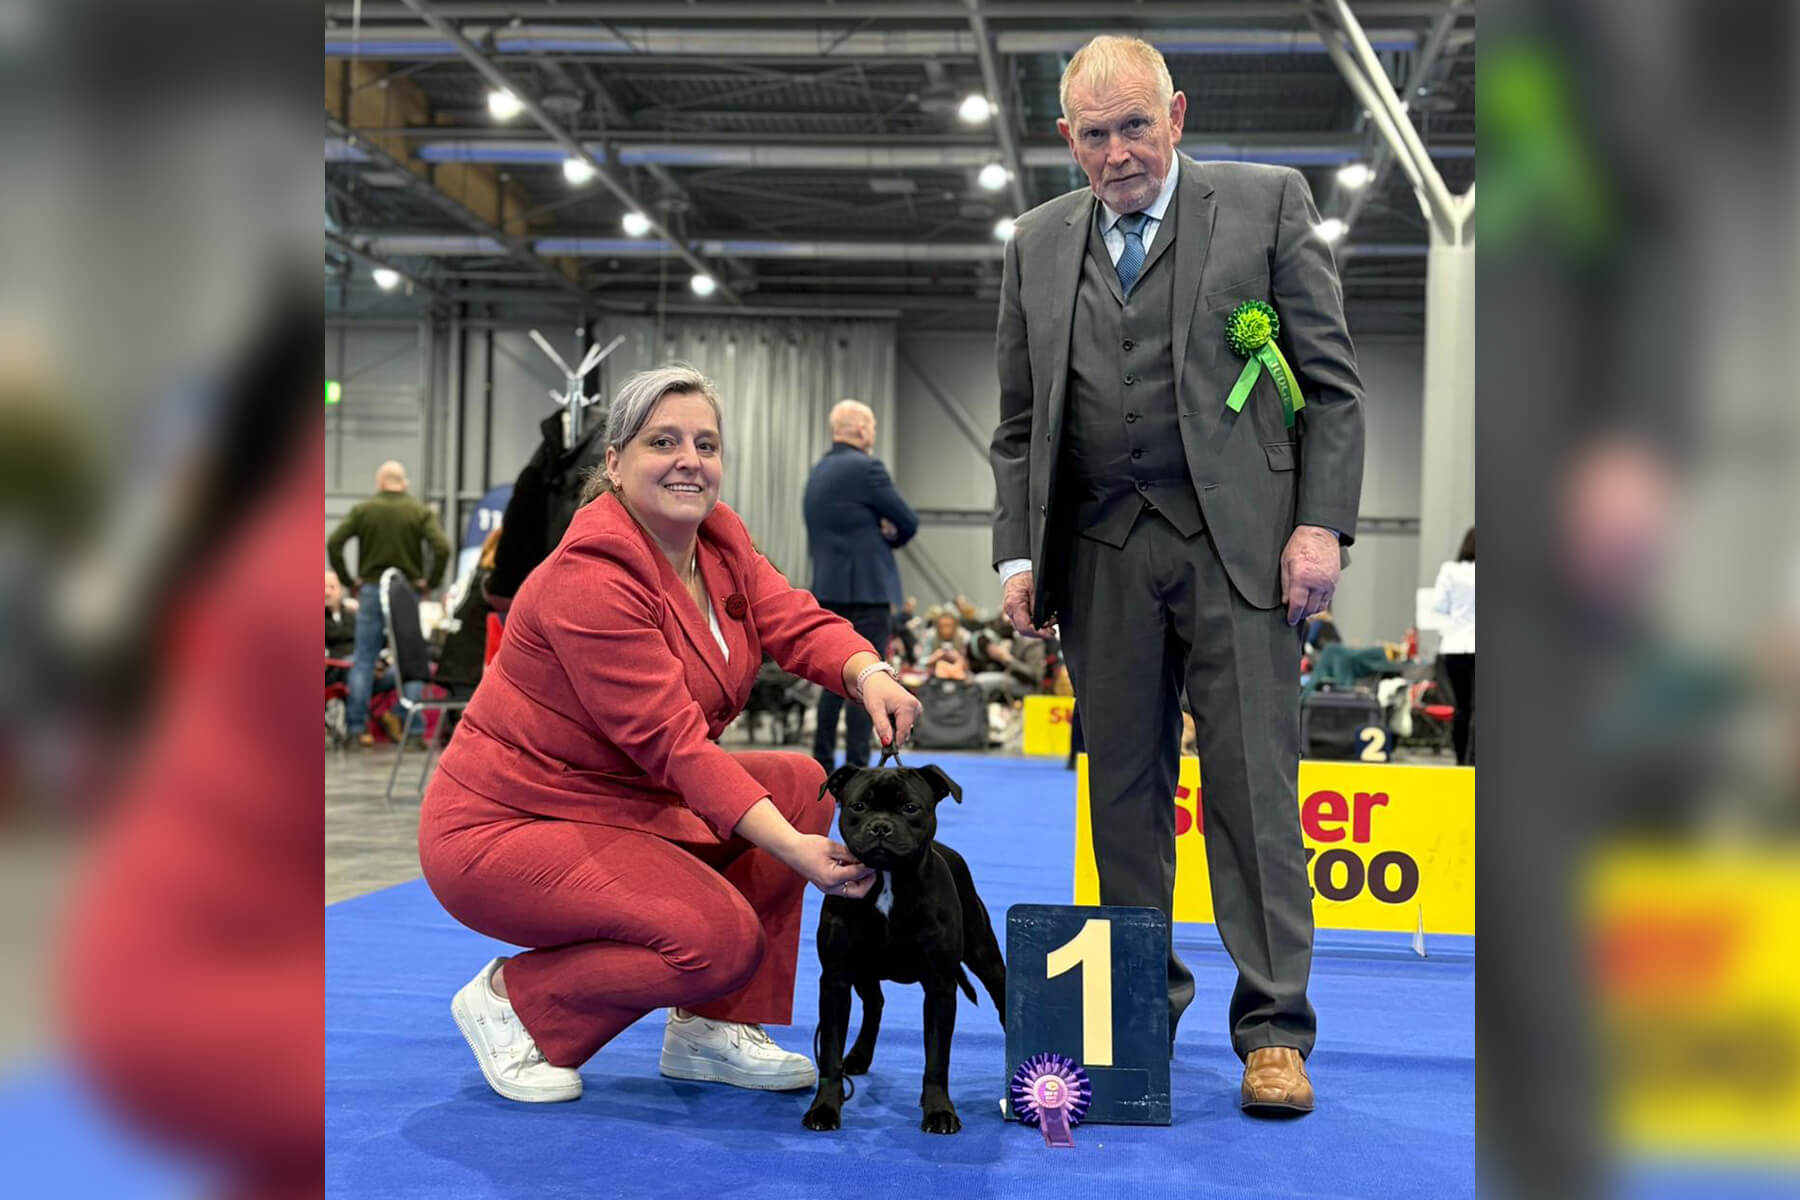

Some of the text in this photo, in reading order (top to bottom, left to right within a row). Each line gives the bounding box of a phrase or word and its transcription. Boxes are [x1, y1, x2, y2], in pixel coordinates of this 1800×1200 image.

[1360, 727, 1387, 761] 2
[1174, 785, 1389, 843] ser
[1046, 918, 1113, 1066] 1
